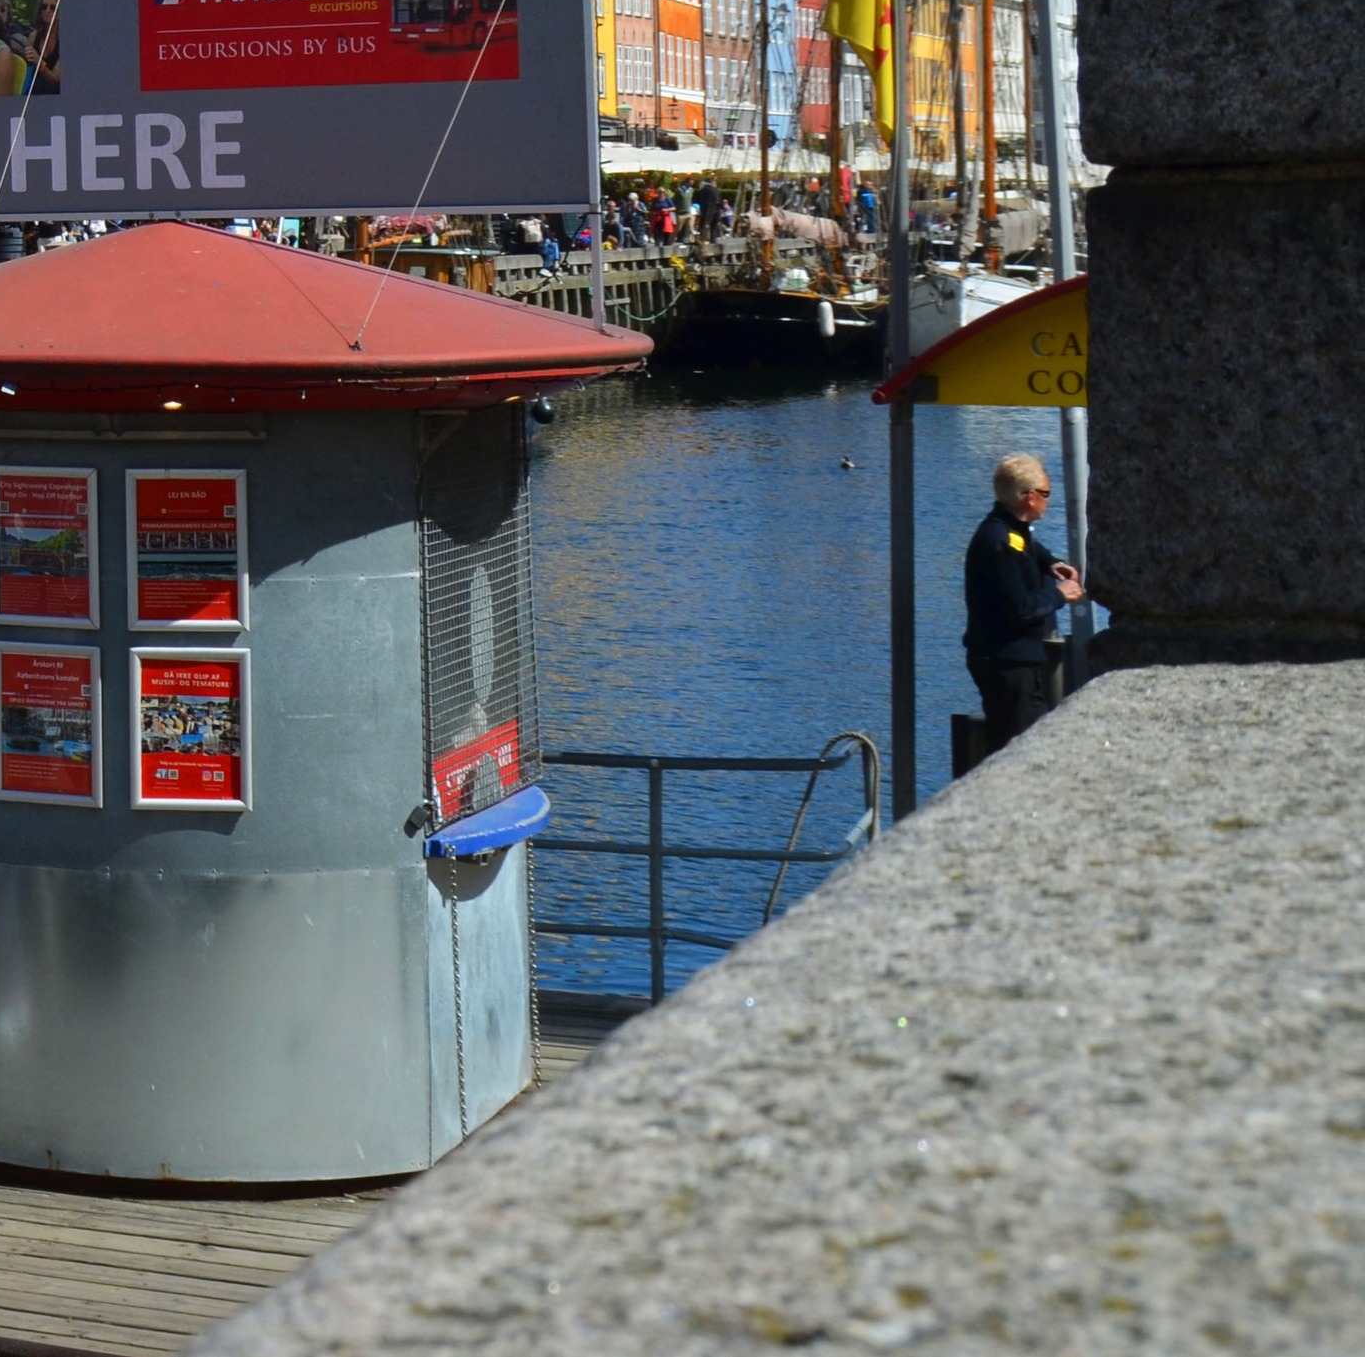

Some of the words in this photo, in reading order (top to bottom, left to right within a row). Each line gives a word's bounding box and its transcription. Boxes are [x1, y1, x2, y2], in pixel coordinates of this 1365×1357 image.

[309, 0, 379, 14] excursions
[158, 39, 293, 60] EXCURSIONS
[302, 38, 327, 55] BY
[337, 35, 377, 54] BUS
[10, 110, 246, 193] HERE
